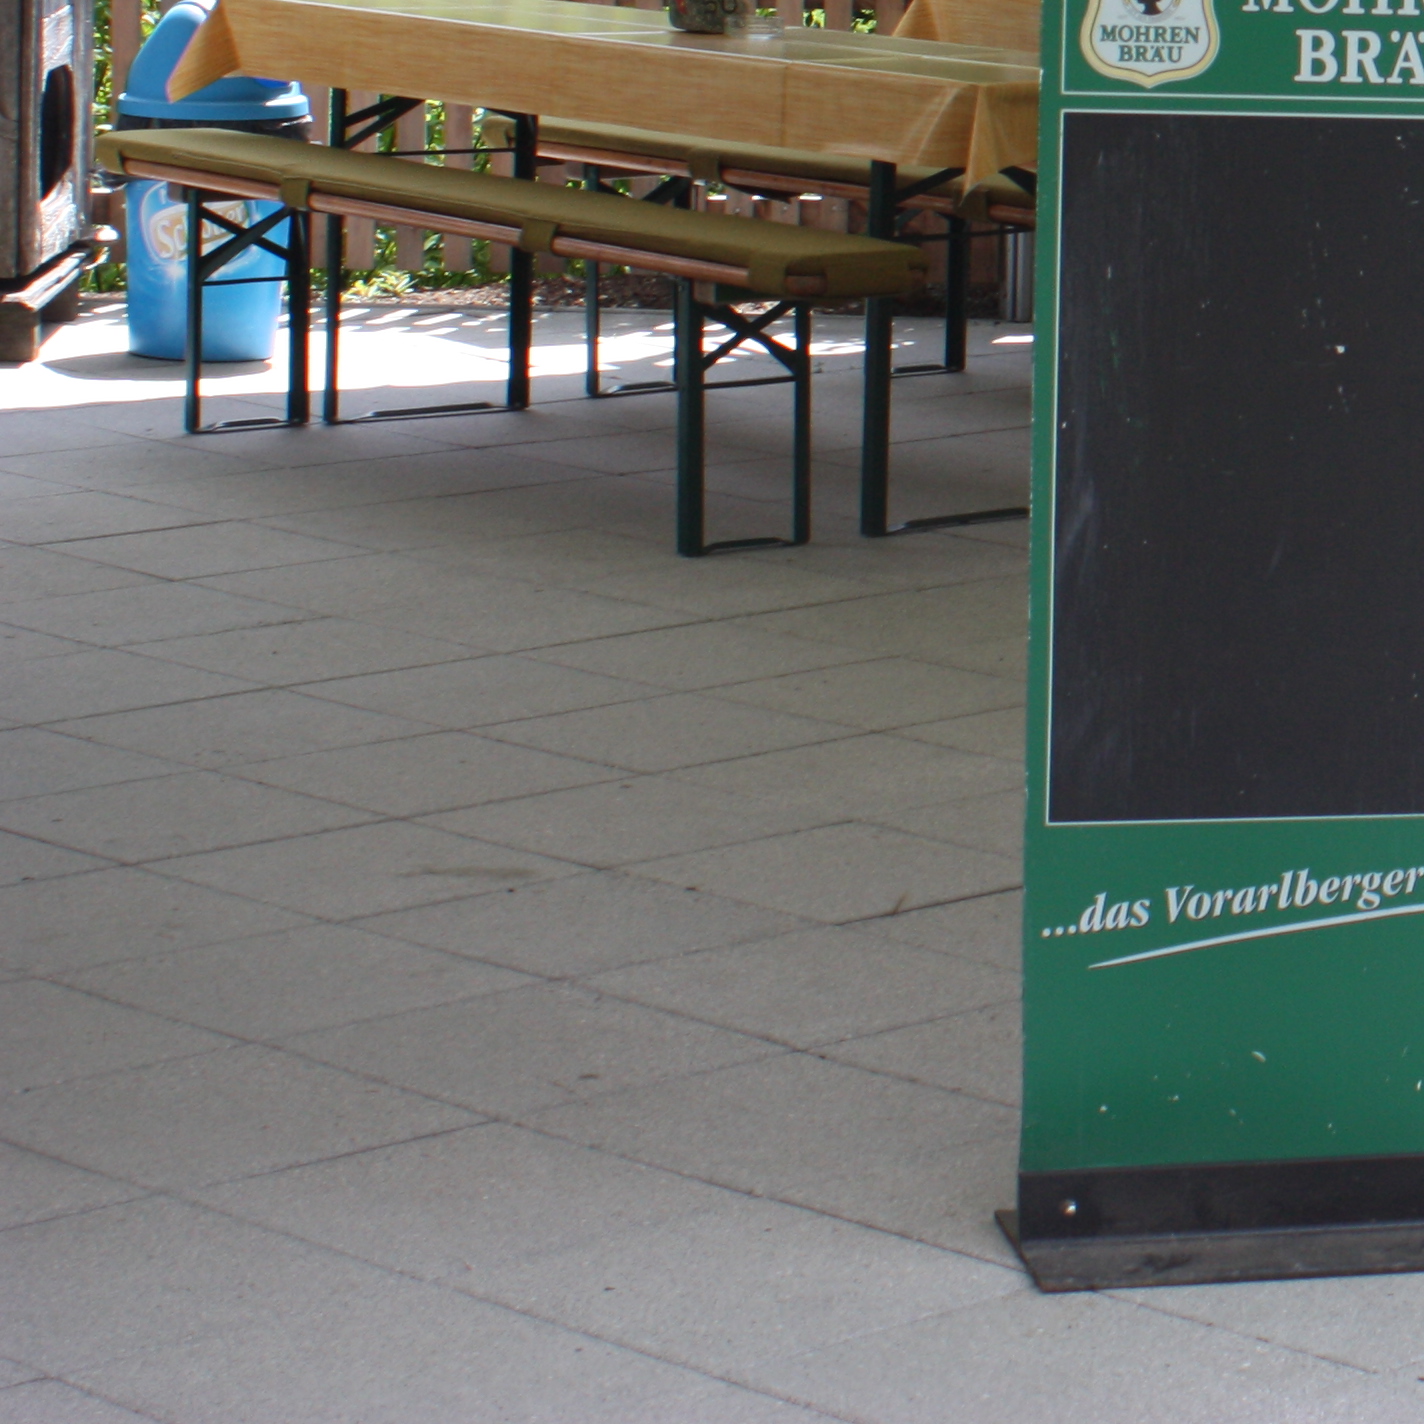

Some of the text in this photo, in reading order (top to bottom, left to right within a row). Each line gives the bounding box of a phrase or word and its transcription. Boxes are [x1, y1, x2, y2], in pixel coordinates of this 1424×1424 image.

[1100, 24, 1201, 44] MOHREN
[1119, 45, 1184, 63] BRÄU
[1165, 866, 1424, 923] Vorarlberger
